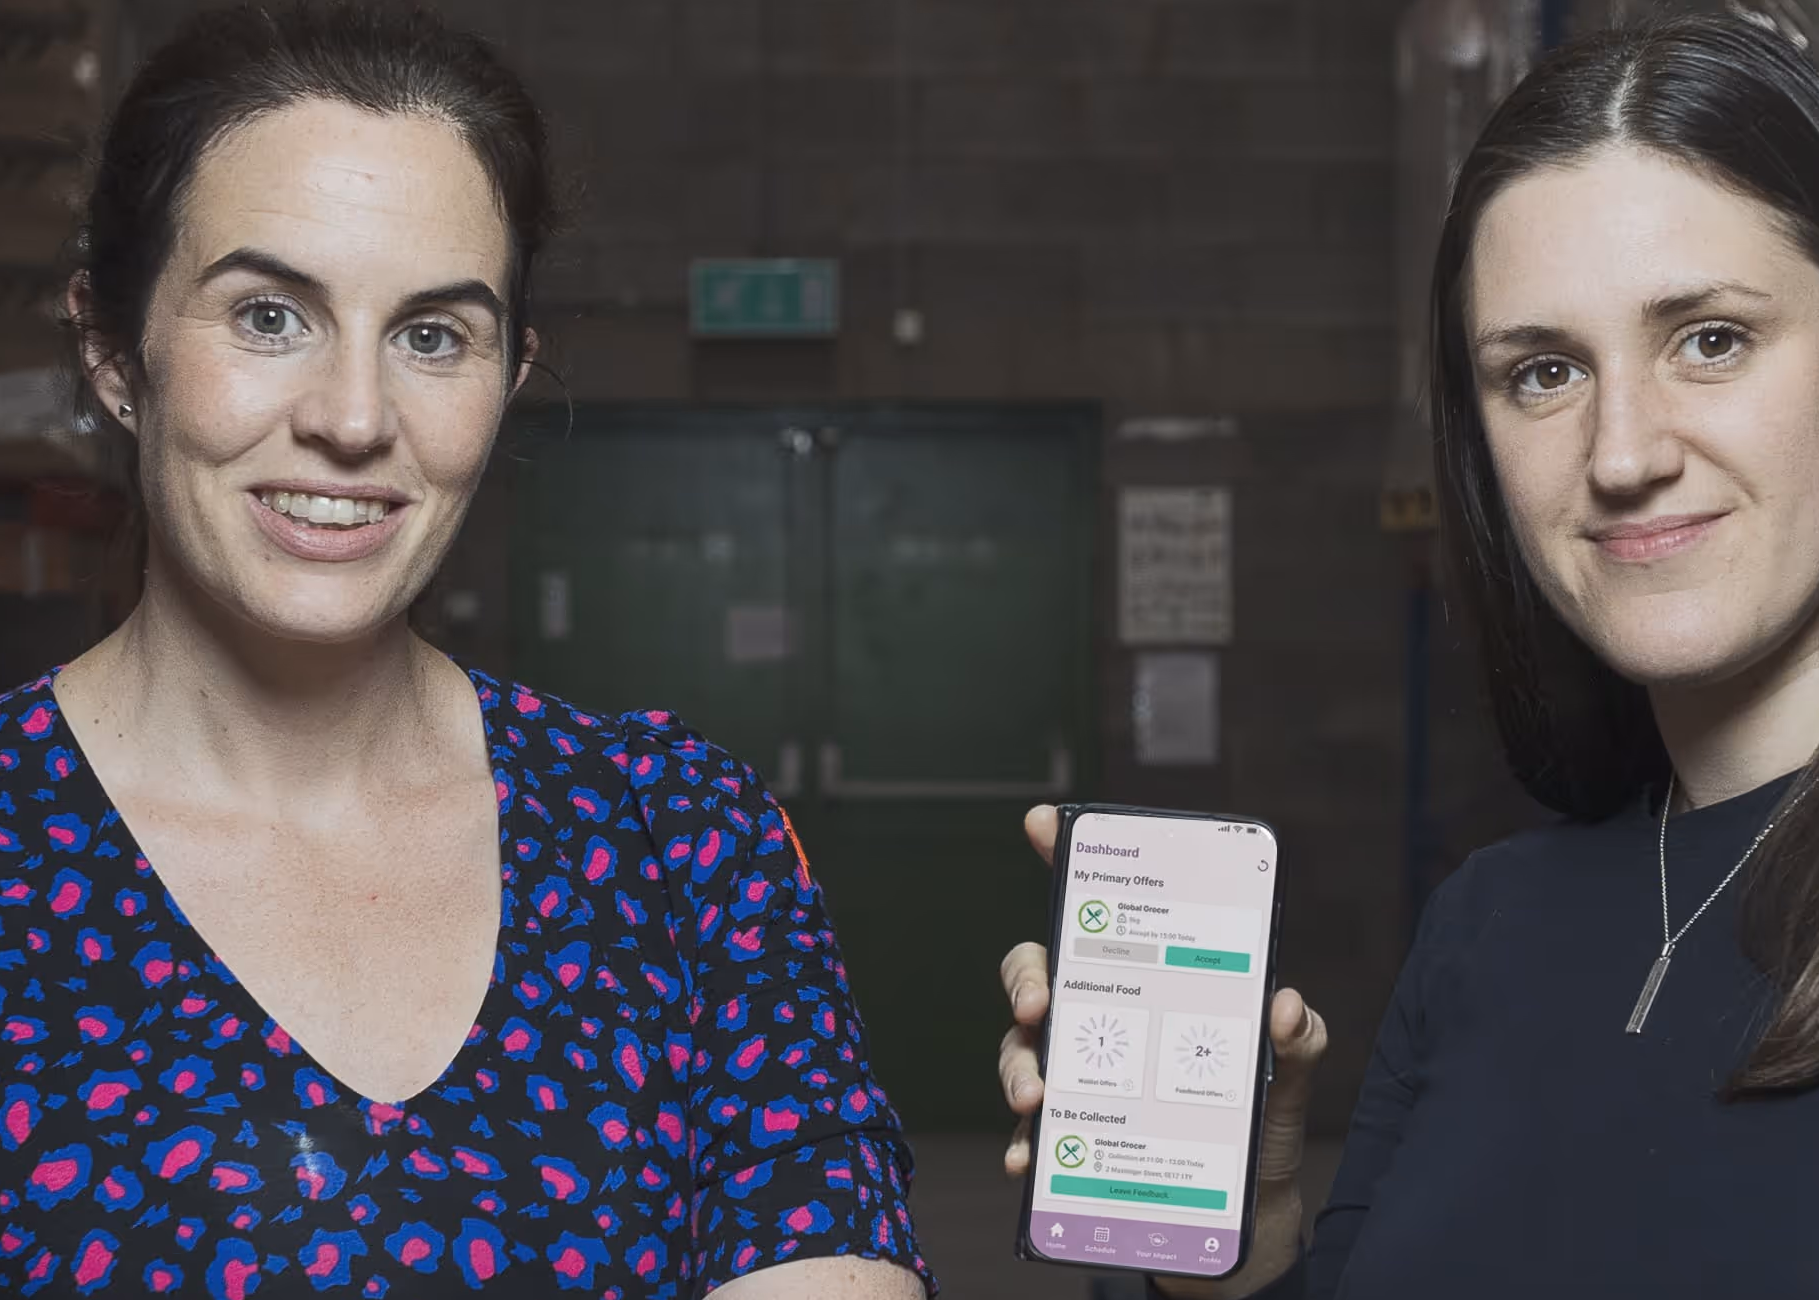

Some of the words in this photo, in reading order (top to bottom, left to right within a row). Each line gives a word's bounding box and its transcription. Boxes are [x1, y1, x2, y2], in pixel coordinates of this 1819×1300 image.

[1076, 841, 1140, 858] Dashboard
[1074, 870, 1090, 882] My
[1092, 871, 1132, 887] Primary
[1133, 875, 1165, 888] Offers
[1117, 902, 1143, 913] Global
[1143, 905, 1170, 915] Grocer
[1102, 945, 1131, 957] Decline
[1194, 954, 1222, 966] Accept
[1063, 979, 1114, 994] Additional
[1116, 984, 1142, 997] Food
[1098, 1036, 1105, 1048] 1
[1195, 1044, 1213, 1058] 2+
[1050, 1108, 1062, 1119] To
[1064, 1109, 1078, 1121] Be
[1079, 1111, 1127, 1125] Collected
[1094, 1138, 1120, 1149] Global
[1120, 1140, 1147, 1151] Grocer
[1109, 1186, 1131, 1196] Leave
[1132, 1189, 1170, 1200] Feedback
[1085, 1245, 1117, 1255] Schedule
